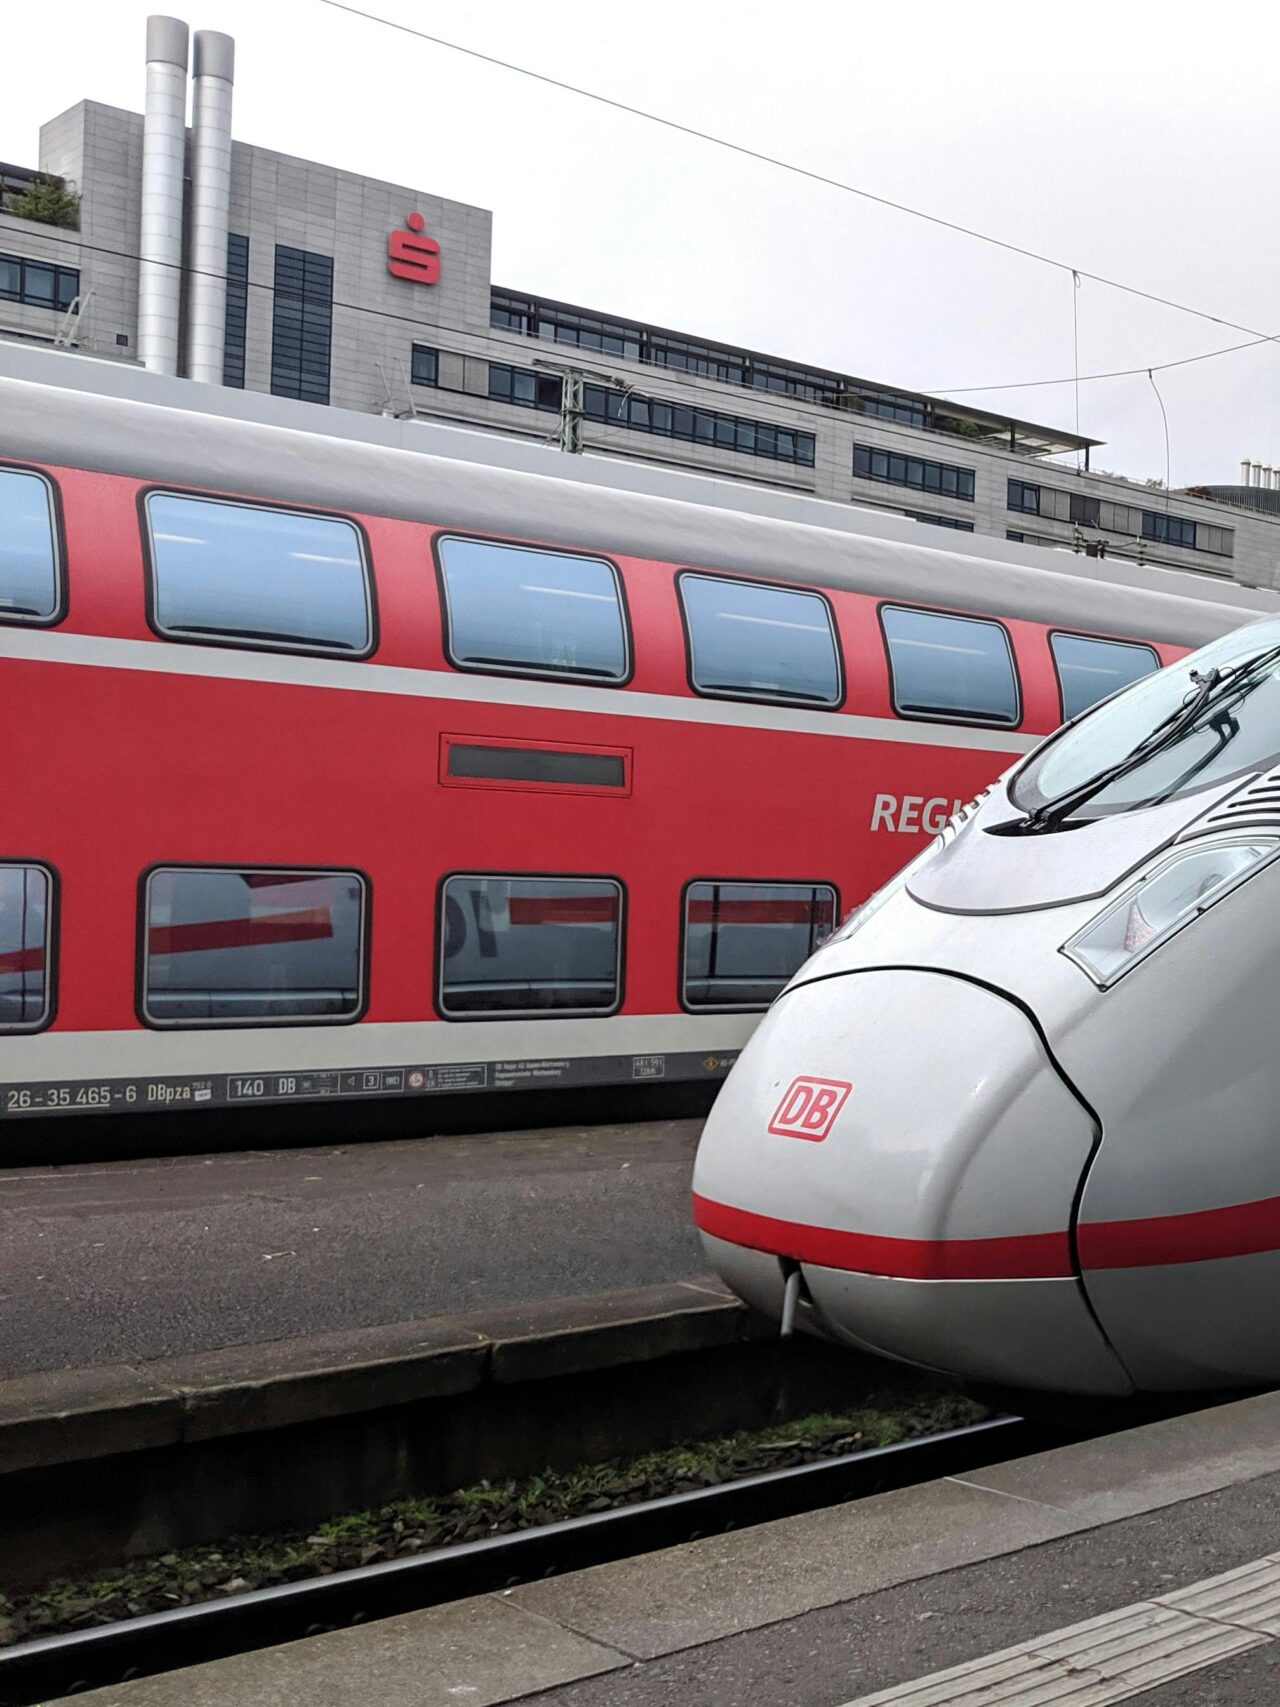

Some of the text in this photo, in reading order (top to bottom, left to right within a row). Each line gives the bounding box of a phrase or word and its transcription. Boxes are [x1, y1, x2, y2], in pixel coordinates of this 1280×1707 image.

[147, 1084, 191, 1104] DBpza
[235, 1079, 264, 1097] 140
[278, 1077, 296, 1094] DB
[777, 1084, 839, 1131] DB
